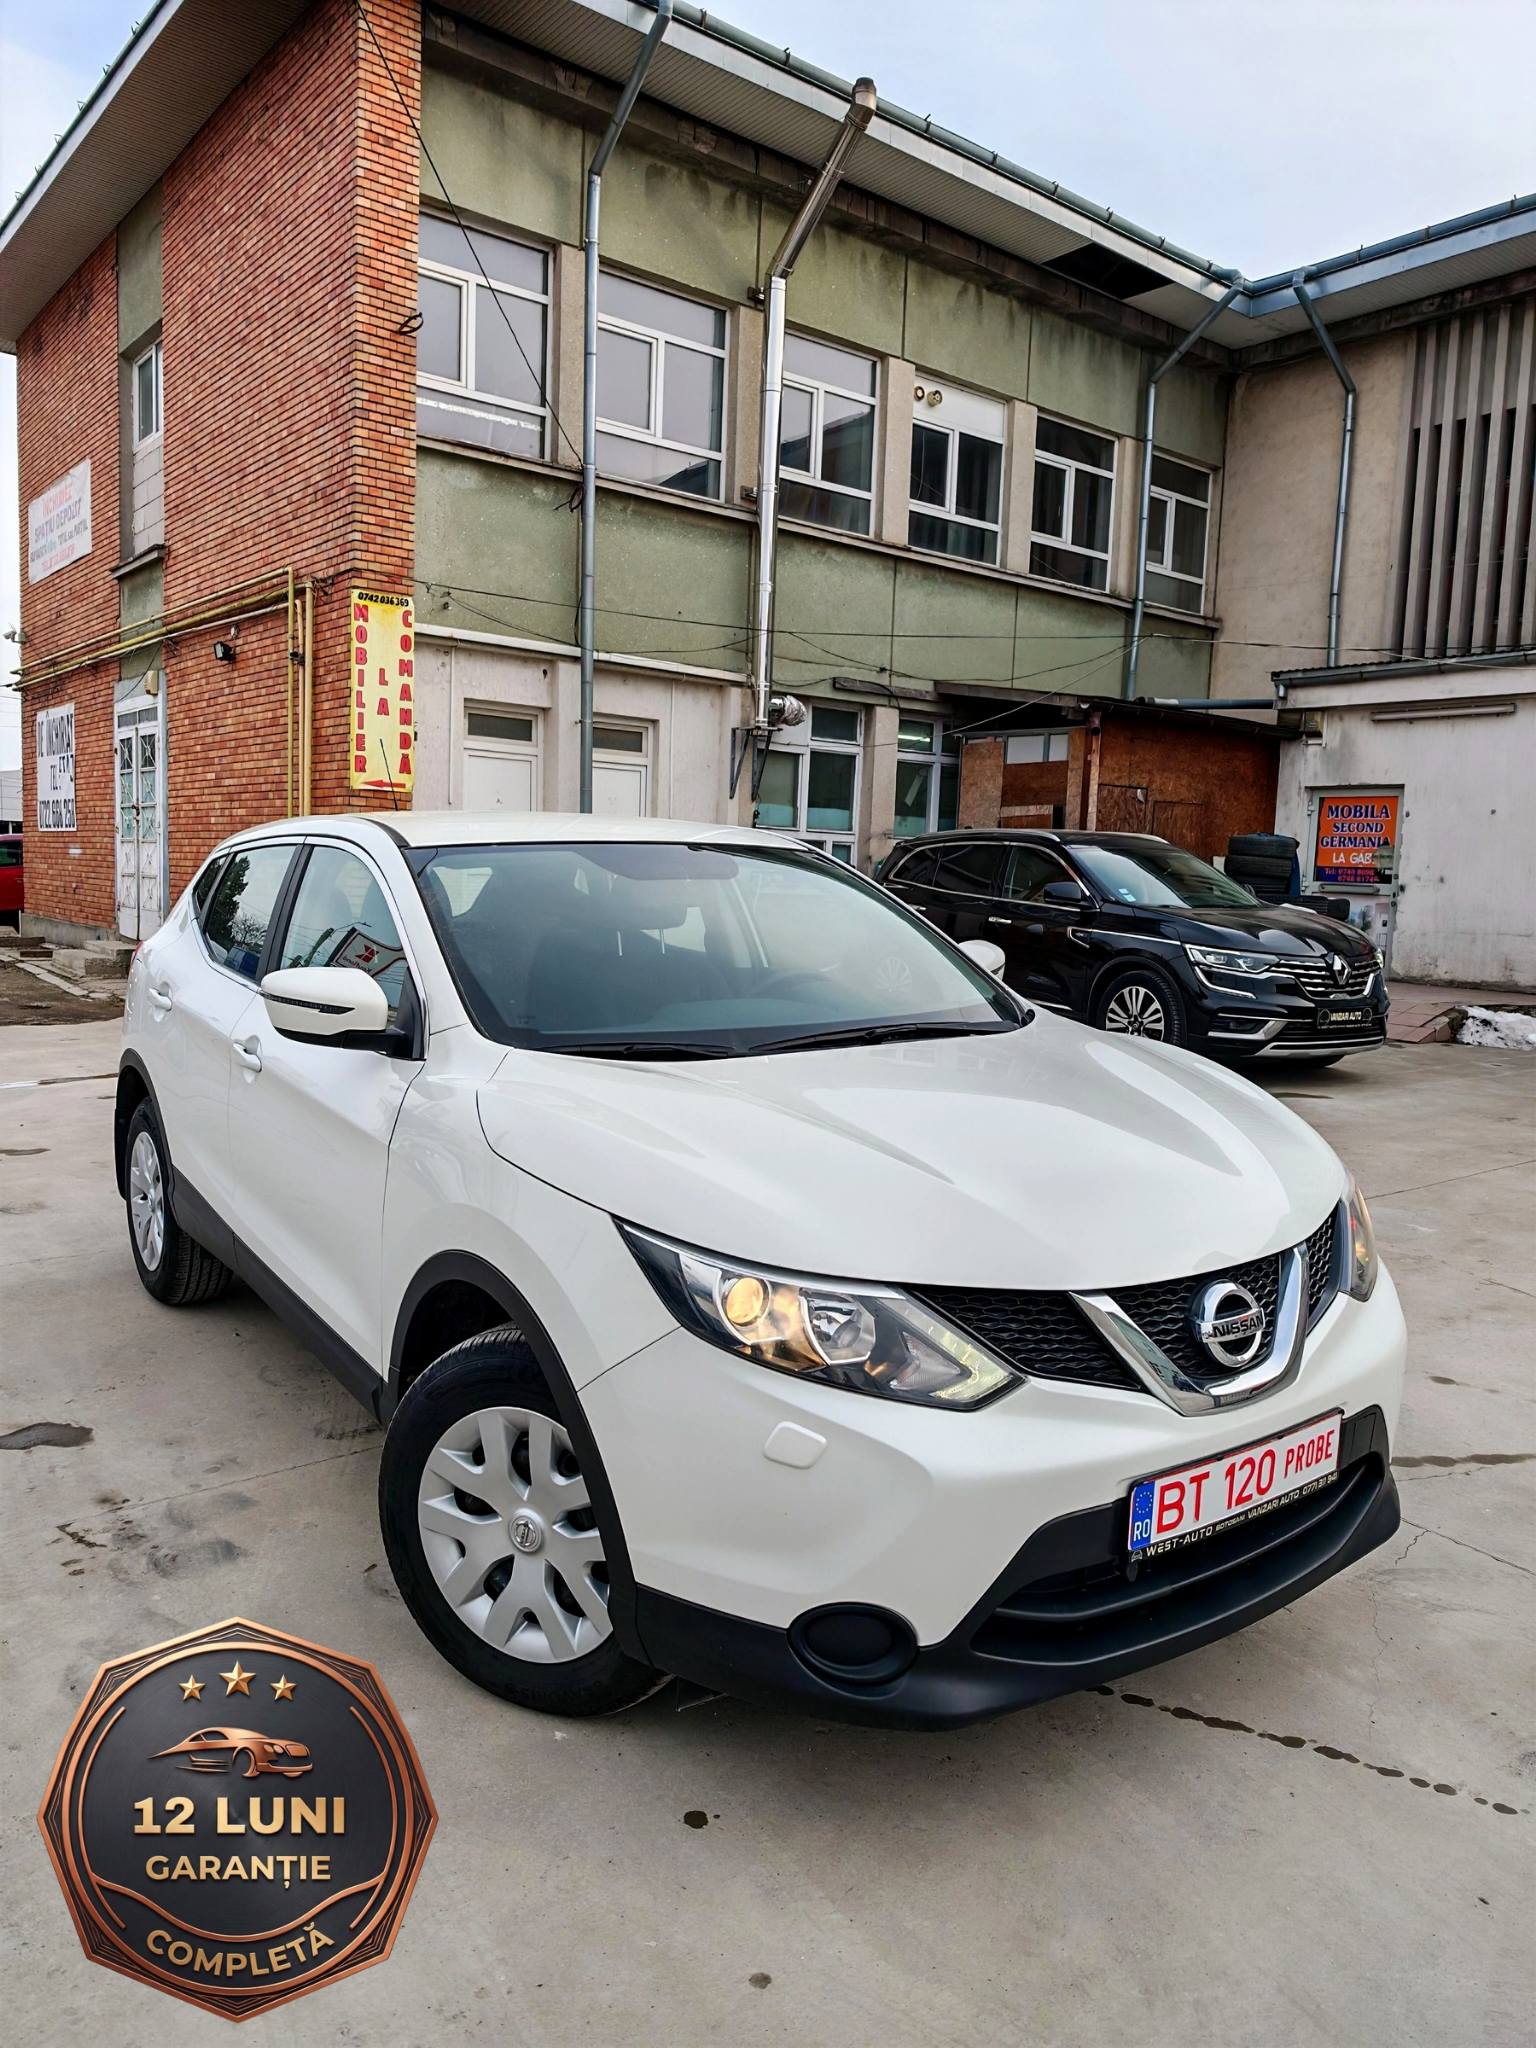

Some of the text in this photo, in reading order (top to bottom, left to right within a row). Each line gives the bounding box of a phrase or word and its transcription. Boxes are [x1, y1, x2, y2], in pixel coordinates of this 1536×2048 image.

[1327, 804, 1391, 820] MOBILA
[1332, 822, 1385, 833] SECOND
[1320, 835, 1391, 849] GERMANIA
[1332, 852, 1346, 864] LA
[1212, 1315, 1264, 1338] NISSAN
[1156, 1429, 1336, 1534] BT 120 PROBE
[1133, 1519, 1151, 1542] RO
[1146, 1526, 1213, 1557] WEST-AUTO
[1279, 1489, 1301, 1507] AUTO
